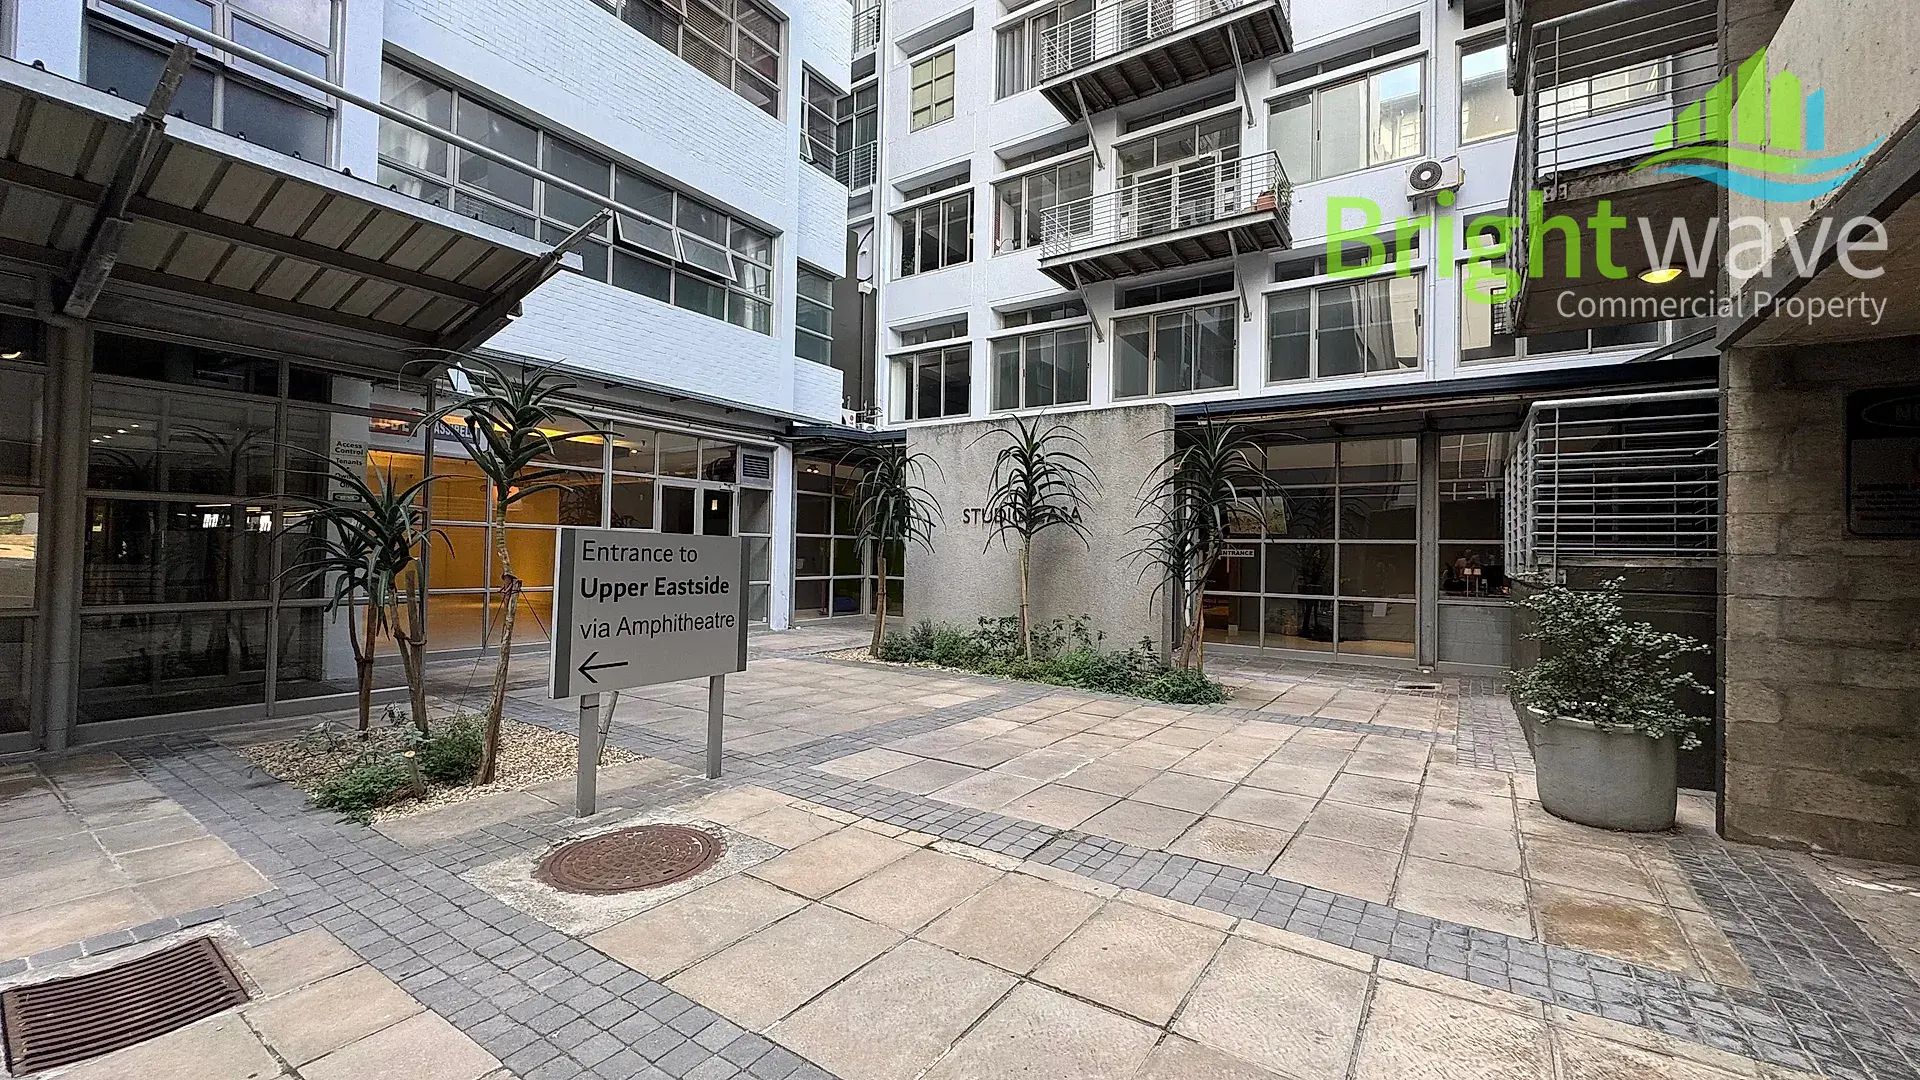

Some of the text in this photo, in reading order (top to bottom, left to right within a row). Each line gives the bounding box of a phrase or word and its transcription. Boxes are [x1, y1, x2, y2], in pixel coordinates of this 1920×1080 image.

[335, 447, 364, 455] Control
[336, 440, 363, 449] Access
[335, 457, 363, 466] Tenants
[582, 540, 698, 563] Entrance to
[580, 575, 730, 603] Upper Eastside
[580, 612, 735, 639] via Amphitheatre
